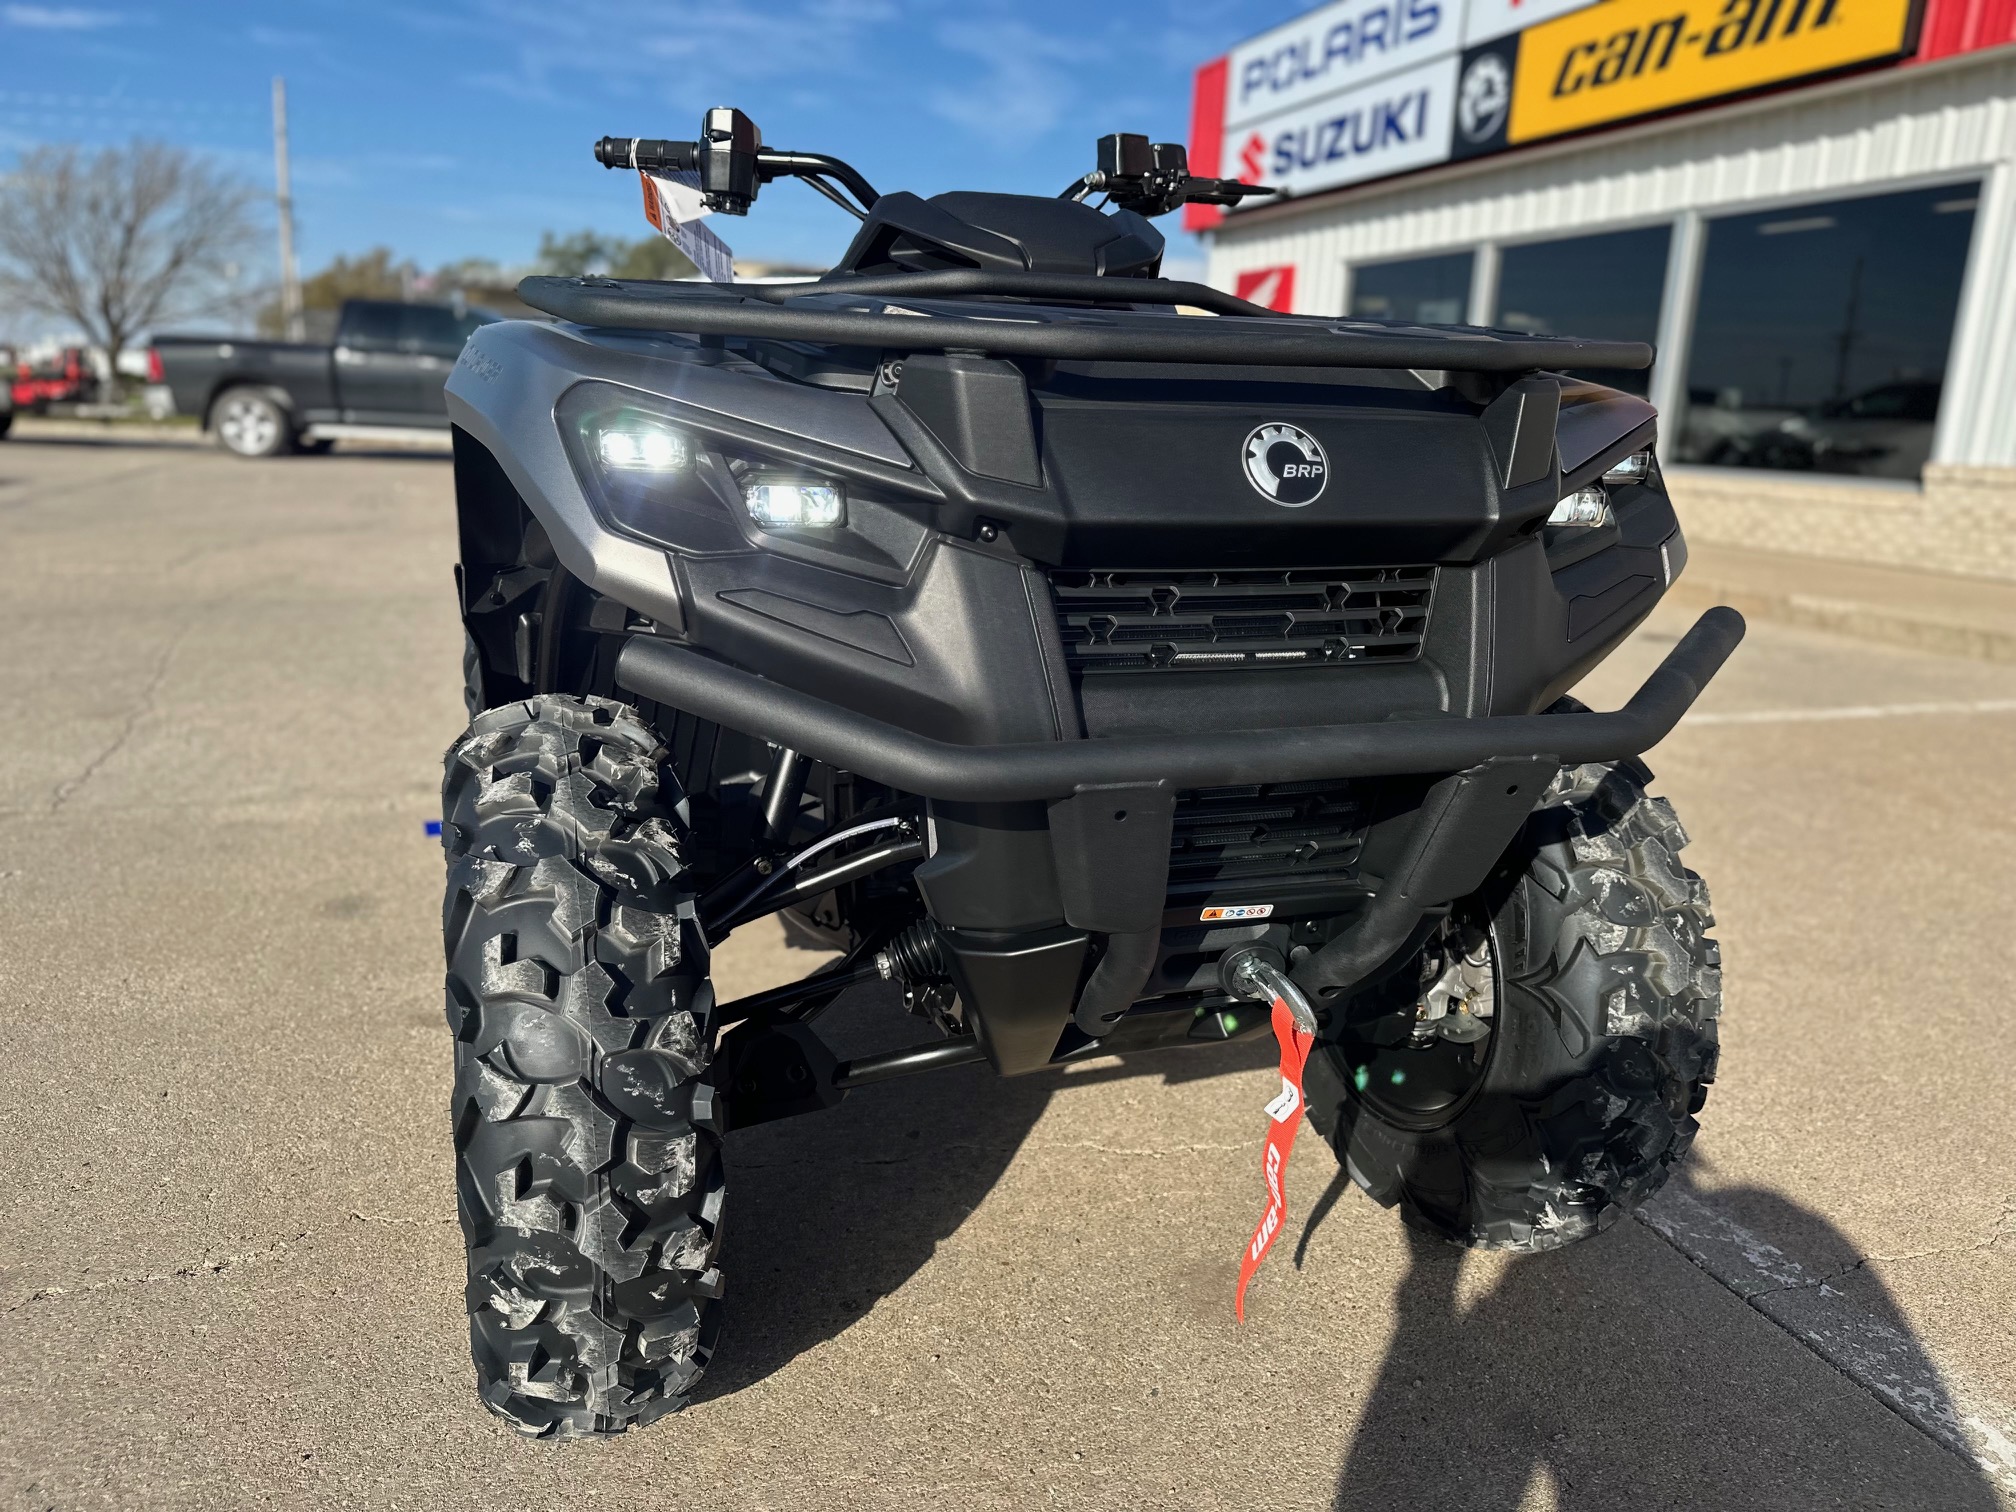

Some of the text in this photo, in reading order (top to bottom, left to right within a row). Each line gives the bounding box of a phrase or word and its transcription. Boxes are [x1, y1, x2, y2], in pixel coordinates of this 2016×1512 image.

[1240, 0, 1441, 103] POLARIS
[1272, 88, 1429, 177] SUZUKI
[1283, 464, 1324, 478] BRP
